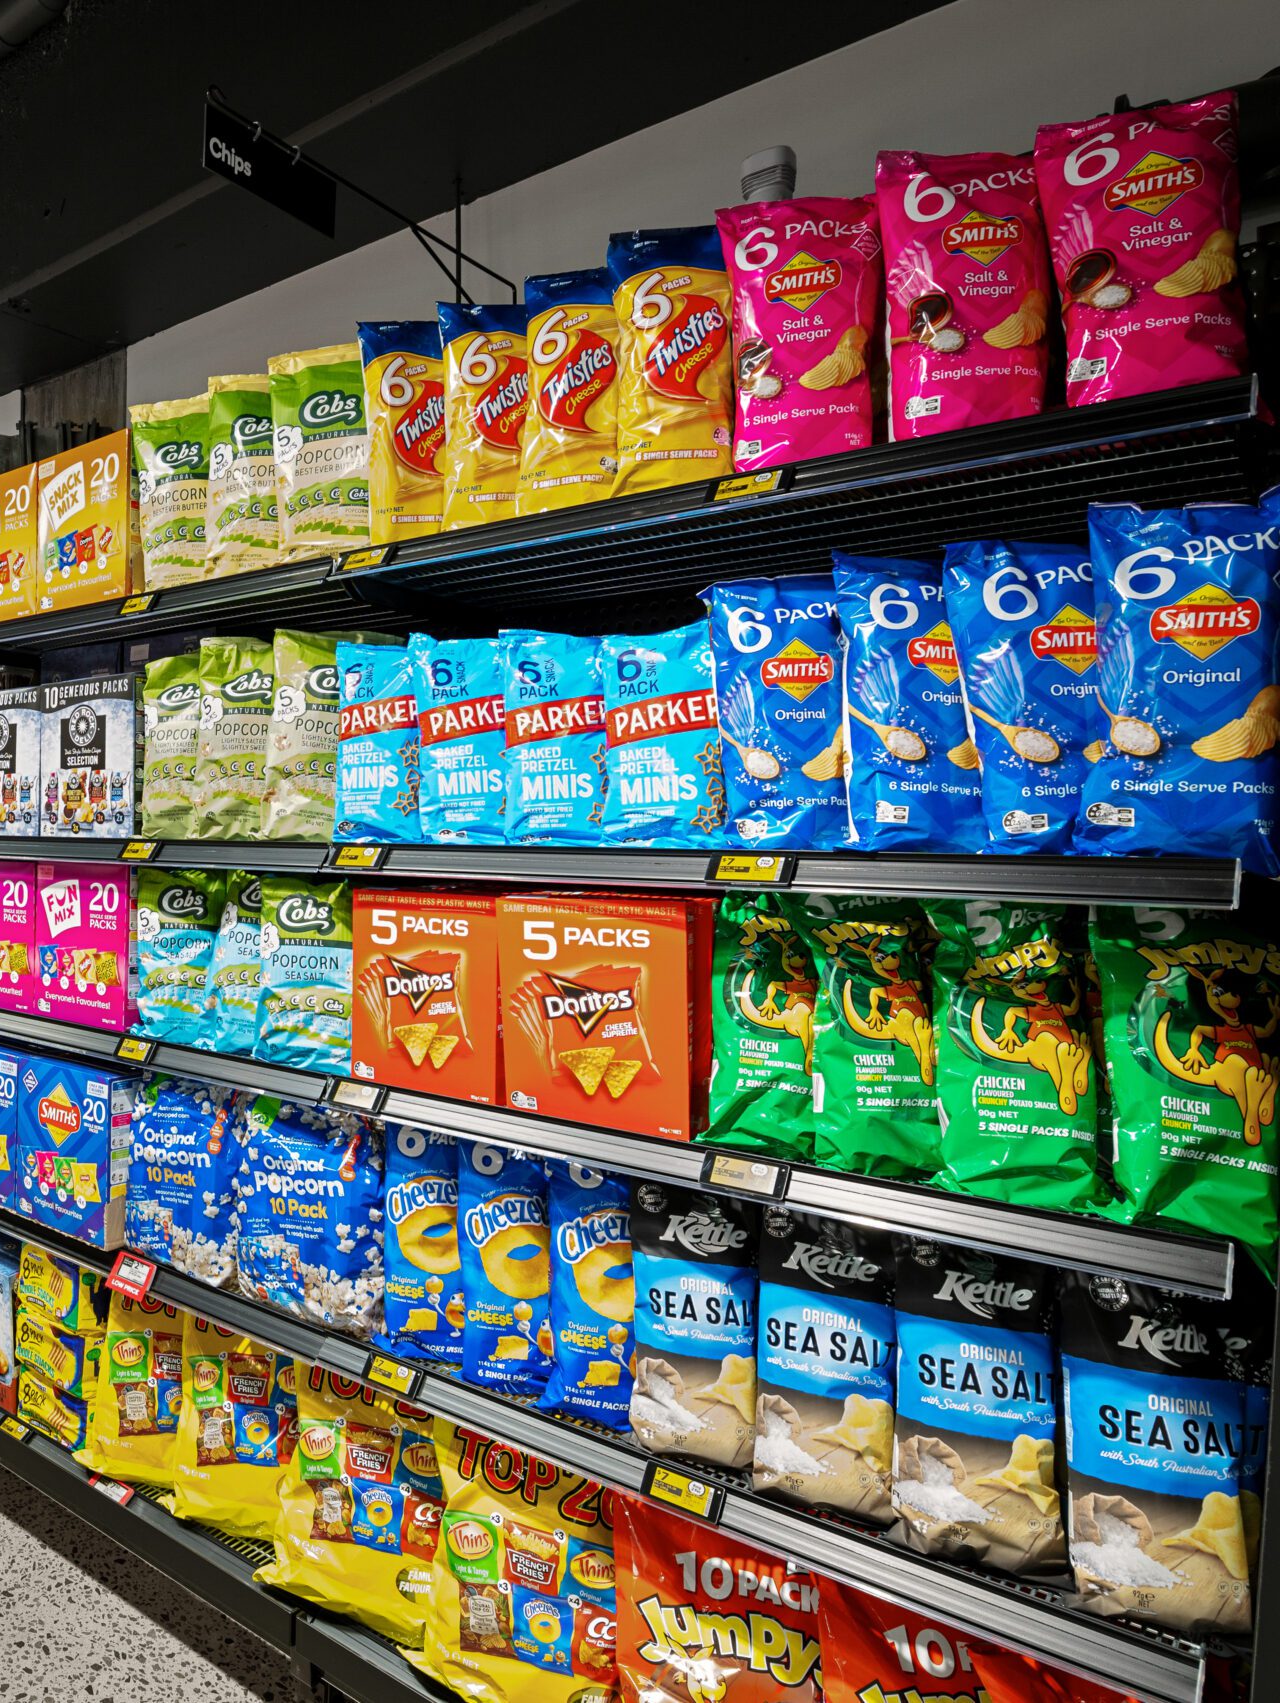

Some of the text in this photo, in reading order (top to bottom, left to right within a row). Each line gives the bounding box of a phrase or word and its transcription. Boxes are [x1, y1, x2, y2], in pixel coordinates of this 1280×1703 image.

[210, 137, 251, 176] Chips
[1063, 133, 1120, 185] 6
[1111, 167, 1196, 203] SMITH'S
[948, 224, 1018, 245] SMITH'S
[1122, 231, 1192, 251] Vinegar
[770, 267, 836, 293] SMITH'S
[965, 271, 1008, 283] Salt &
[958, 282, 1015, 297] Vinegar
[631, 272, 691, 329] 6 PACKS
[782, 315, 824, 331] Salt &
[648, 306, 724, 376] Twisties
[776, 328, 831, 343] Vinegar
[675, 343, 713, 383] Cheese
[543, 343, 612, 406] Twisties
[303, 393, 358, 421] Cobs
[753, 412, 788, 426] Single
[791, 407, 825, 418] Serve
[309, 430, 350, 441] NATURAL
[160, 443, 202, 465] Cobs
[295, 445, 364, 466] POPCORN
[635, 450, 717, 461] 6 SINGLE SERVE PACKS
[90, 453, 119, 487] 20
[5, 485, 30, 516] 20
[151, 487, 207, 506] POPCORN
[5, 519, 28, 531] PACKS
[869, 583, 919, 629] 6
[728, 606, 772, 653] 6
[1156, 607, 1251, 631] SMITH'S
[617, 650, 641, 682] 6
[765, 657, 829, 679] SMITH'S
[226, 673, 272, 698] Cobs
[1163, 669, 1240, 686] Original
[45, 679, 128, 708] 10 GENEROUS PACKS
[520, 684, 558, 698] PACK
[775, 708, 825, 722] Original
[67, 756, 98, 766] SELECTION
[342, 766, 398, 789] MINIS
[438, 769, 503, 796] MINIS
[522, 774, 593, 800] MINIS
[1111, 781, 1274, 794] 6 Single Serve Packs
[621, 774, 697, 805] MINIS
[3, 880, 28, 907] 20
[89, 883, 119, 913] 20
[162, 889, 204, 915] Cobs
[279, 898, 329, 929] Cobs
[504, 904, 524, 913] SAME
[527, 904, 552, 914] GREAT
[584, 906, 604, 915] LESS
[607, 906, 643, 915] PLASTIC
[646, 907, 677, 916] WASTE
[90, 920, 116, 930] PACKS
[371, 910, 469, 944] 5 PACKS
[965, 901, 1002, 945] 5
[154, 936, 211, 950] POPCORN
[523, 920, 650, 960] 5 PACKS
[272, 955, 339, 969] POPCORN
[386, 972, 453, 997] Doritos
[324, 1000, 344, 1013] Cobs
[546, 990, 632, 1018] Doritos
[605, 1022, 632, 1031] CHEESE
[740, 1039, 778, 1053] CHICKEN
[853, 1054, 894, 1066] CHICKEN
[978, 1075, 1026, 1091] CHICKEN
[979, 1089, 1014, 1098] FLAVOURED
[83, 1098, 105, 1124] 20
[979, 1109, 1018, 1119] 90g NET
[1161, 1096, 1210, 1115] CHICKEN
[1161, 1110, 1198, 1122] FLAVOURED
[397, 1126, 426, 1157] 6
[472, 1141, 503, 1175] 6
[254, 1171, 344, 1196] Popcorn
[270, 1198, 328, 1219] 10 Pack
[112, 1279, 140, 1295] LOW PRICE
[386, 1283, 424, 1299] CHEESE
[680, 1278, 734, 1296] ORIGINAL
[933, 1271, 1034, 1319] Kettle
[468, 1310, 513, 1326] CHEESE
[568, 1321, 599, 1333] Original
[803, 1308, 863, 1333] ORIGINAL
[561, 1330, 606, 1349] CHEESE
[666, 1326, 688, 1338] South
[691, 1329, 733, 1343] Australian
[767, 1318, 896, 1368] SEA SALT
[960, 1344, 1024, 1366] ORIGINAL
[234, 1378, 262, 1387] FRENCH
[1148, 1395, 1213, 1417] ORIGINAL
[303, 1432, 332, 1453] Thins
[353, 1450, 384, 1462] FRENCH
[1100, 1449, 1218, 1478] with South Australian
[449, 1523, 489, 1550] Thins
[512, 1552, 549, 1572] FRENCH
[677, 1551, 819, 1614] 10 PACK
[580, 1591, 601, 1603] Original
[1138, 1599, 1149, 1609] NET
[524, 1601, 560, 1619] Cheezels
[515, 1640, 539, 1653] CHEESE
[884, 1625, 956, 1678] 10
